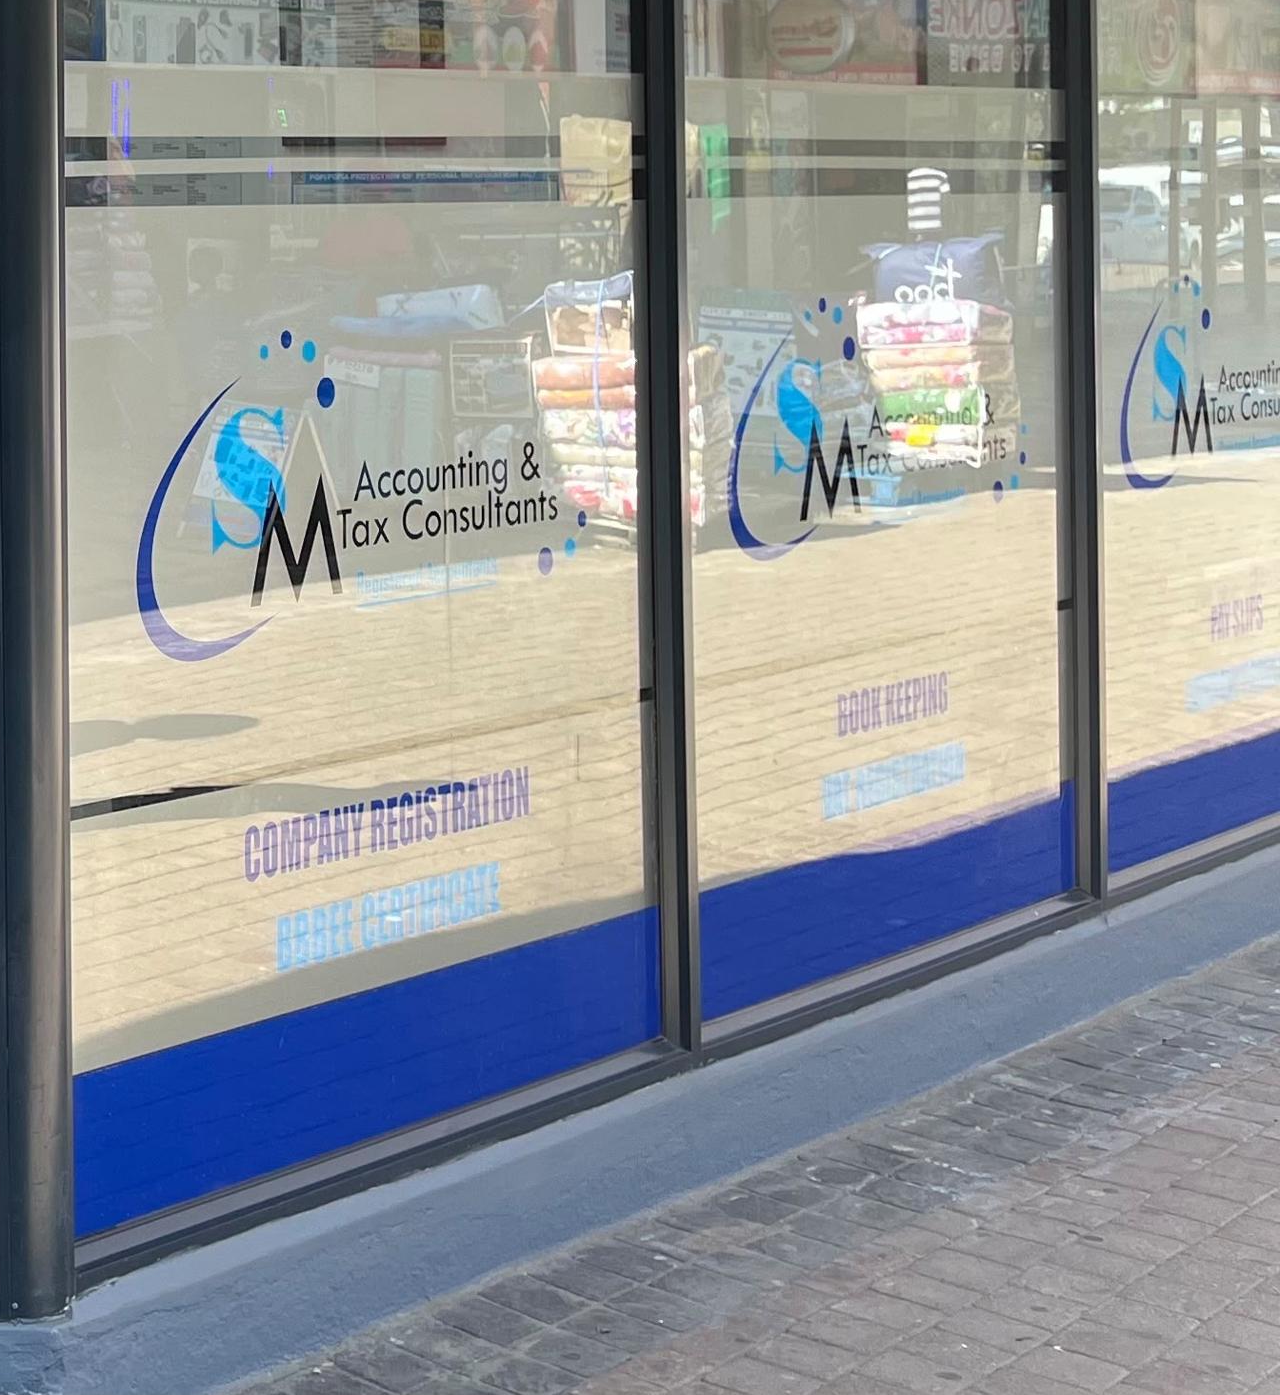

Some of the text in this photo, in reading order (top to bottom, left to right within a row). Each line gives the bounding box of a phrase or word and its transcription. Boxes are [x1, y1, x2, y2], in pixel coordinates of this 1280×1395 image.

[1210, 396, 1236, 426] Tax
[353, 441, 541, 502] Accounting &
[856, 443, 894, 478] Tax
[336, 489, 559, 550] Tax Consultants
[836, 670, 949, 738] BOOK KEEPING
[243, 765, 531, 884] COMPANY REGISTRATION
[358, 860, 502, 952] CERTIFICATE
